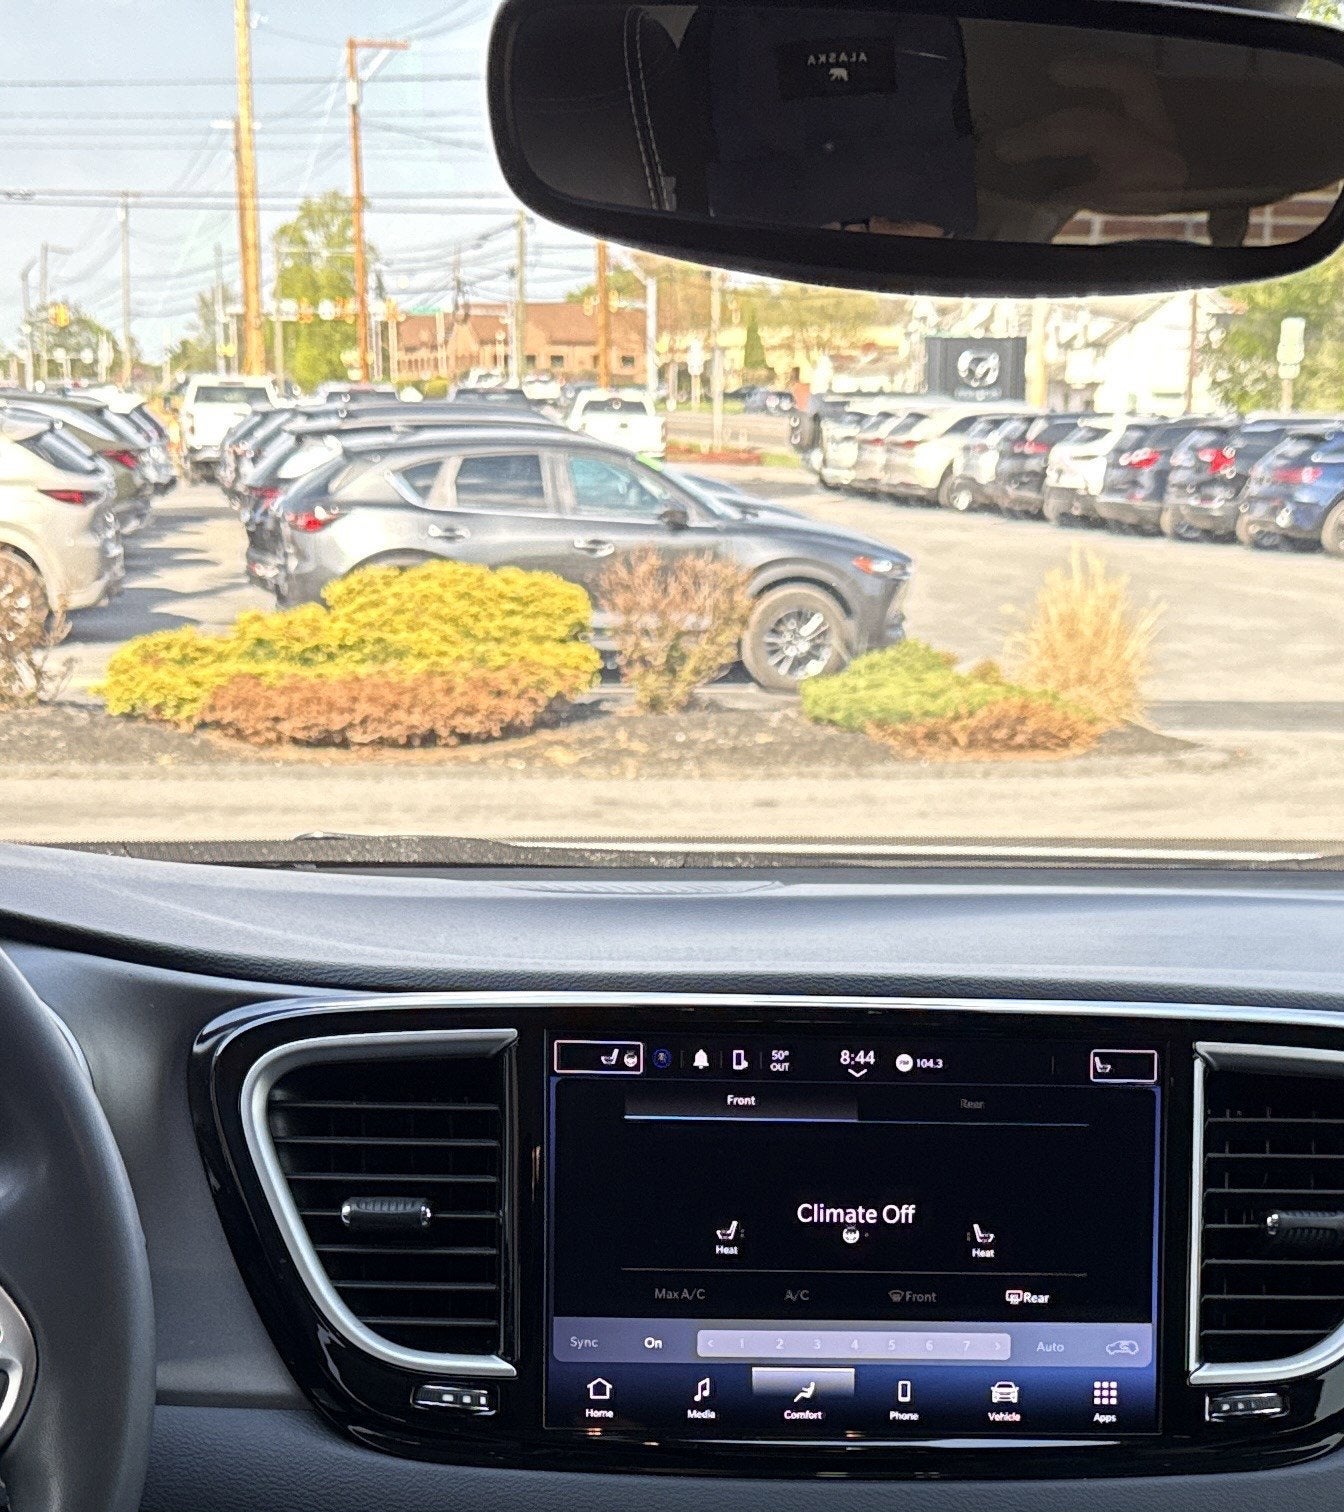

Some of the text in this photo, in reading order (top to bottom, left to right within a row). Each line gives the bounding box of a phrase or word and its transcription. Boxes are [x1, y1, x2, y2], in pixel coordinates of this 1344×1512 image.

[771, 1050, 790, 1061] 50°
[839, 1050, 876, 1066] 8:44
[770, 1063, 790, 1072] OUT
[916, 1058, 944, 1069] 104.3
[726, 1095, 756, 1106] Front
[960, 1098, 985, 1109] Rear
[796, 1203, 916, 1224] Climate Off
[715, 1244, 739, 1255] Heat
[971, 1247, 995, 1258] Heat
[654, 1288, 706, 1301] Max A/C
[784, 1289, 810, 1301] A/C
[905, 1291, 937, 1302] Front
[1023, 1292, 1050, 1304] Rear
[569, 1336, 599, 1349] Sync
[644, 1336, 663, 1349] On
[775, 1338, 785, 1350] 2
[813, 1338, 822, 1350] 3
[850, 1339, 859, 1351] 4
[887, 1339, 896, 1351] 5
[925, 1340, 934, 1351] 6
[1036, 1341, 1065, 1353] Auto
[585, 1408, 614, 1418] Home
[687, 1409, 716, 1419] Media
[784, 1409, 822, 1420] Comfort
[889, 1410, 919, 1421] Phone
[988, 1411, 1021, 1422] Vehicle
[1093, 1412, 1117, 1424] Apps
